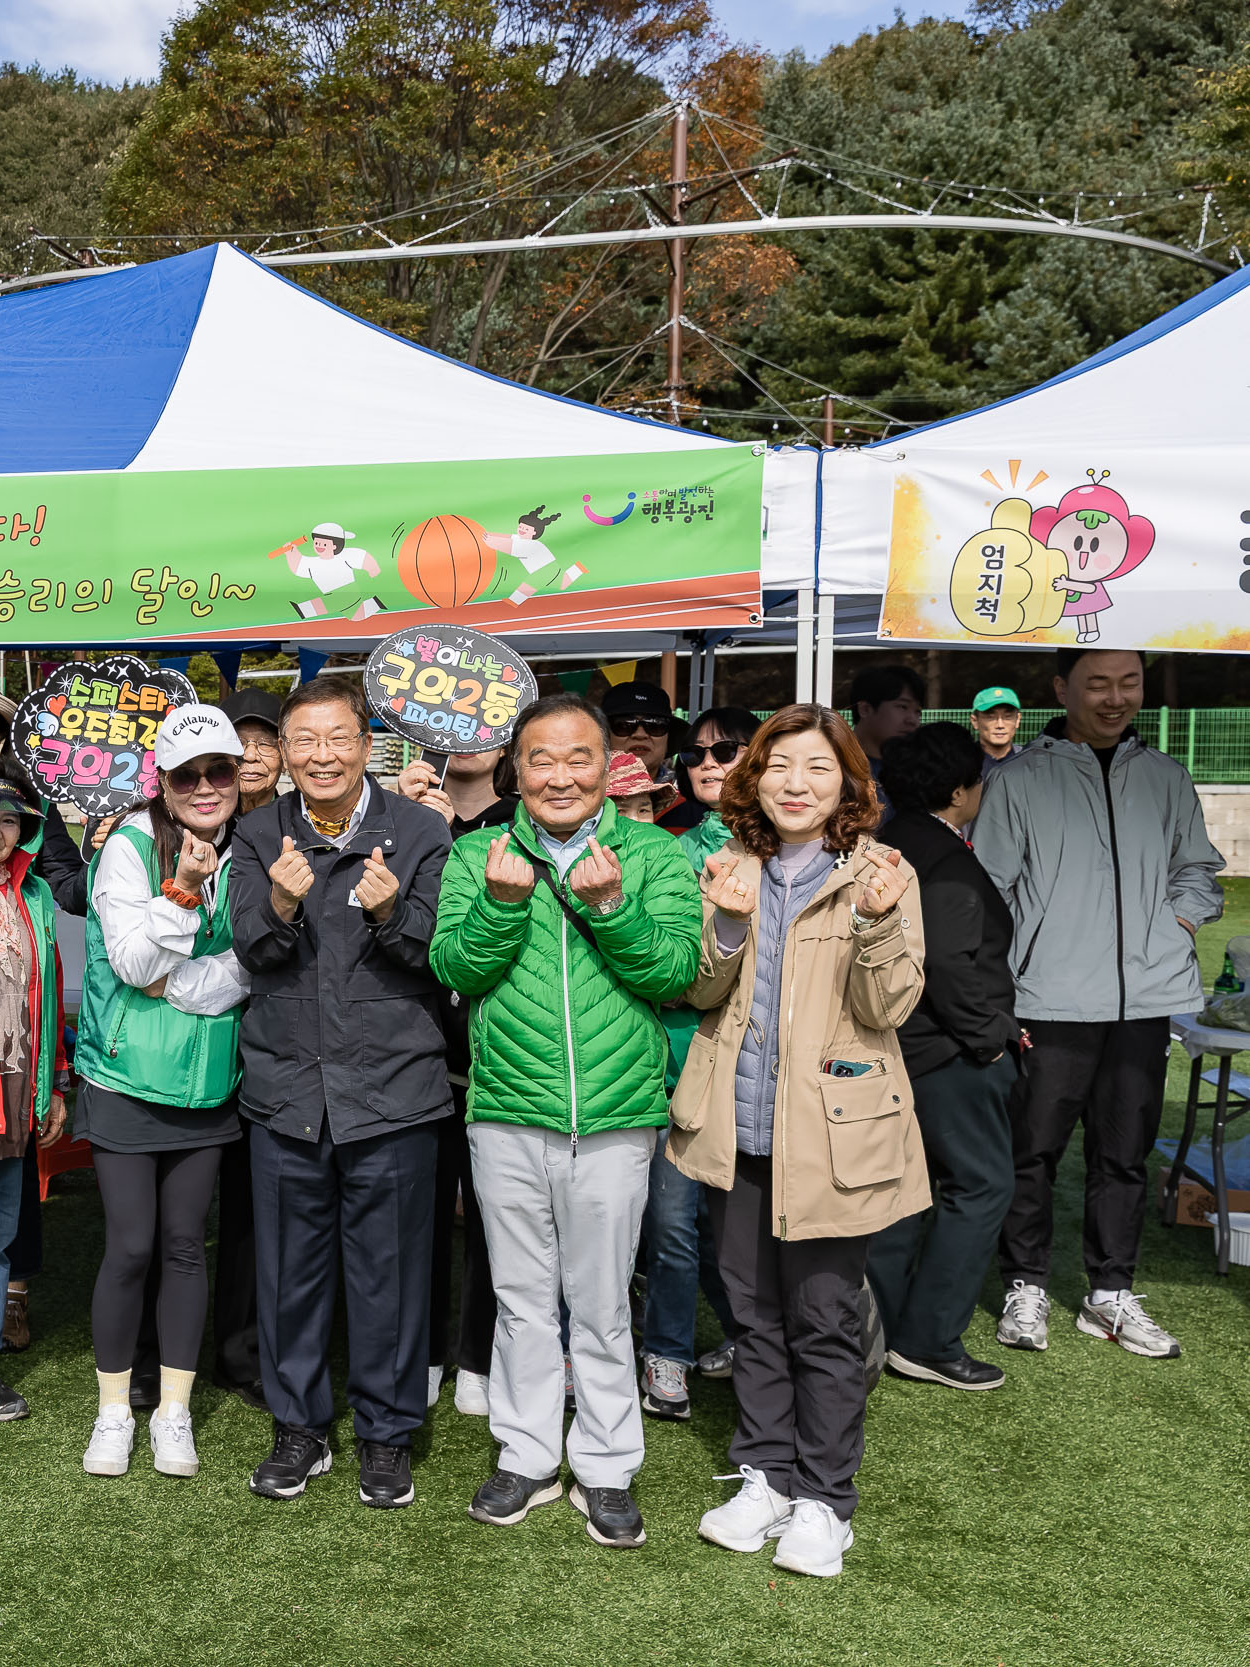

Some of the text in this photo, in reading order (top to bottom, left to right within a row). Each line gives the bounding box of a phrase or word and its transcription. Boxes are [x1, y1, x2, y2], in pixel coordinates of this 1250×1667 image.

[642, 500, 714, 524] 행복광진
[679, 486, 715, 501] 발전하는
[130, 565, 256, 625] 달인~
[974, 544, 1005, 623] 엄지척
[416, 635, 503, 681] 빛이나는
[69, 675, 169, 712] 슈퍼스타
[378, 653, 523, 727] 구의2동
[172, 715, 220, 736] Callaway
[401, 700, 479, 742] 파이팅
